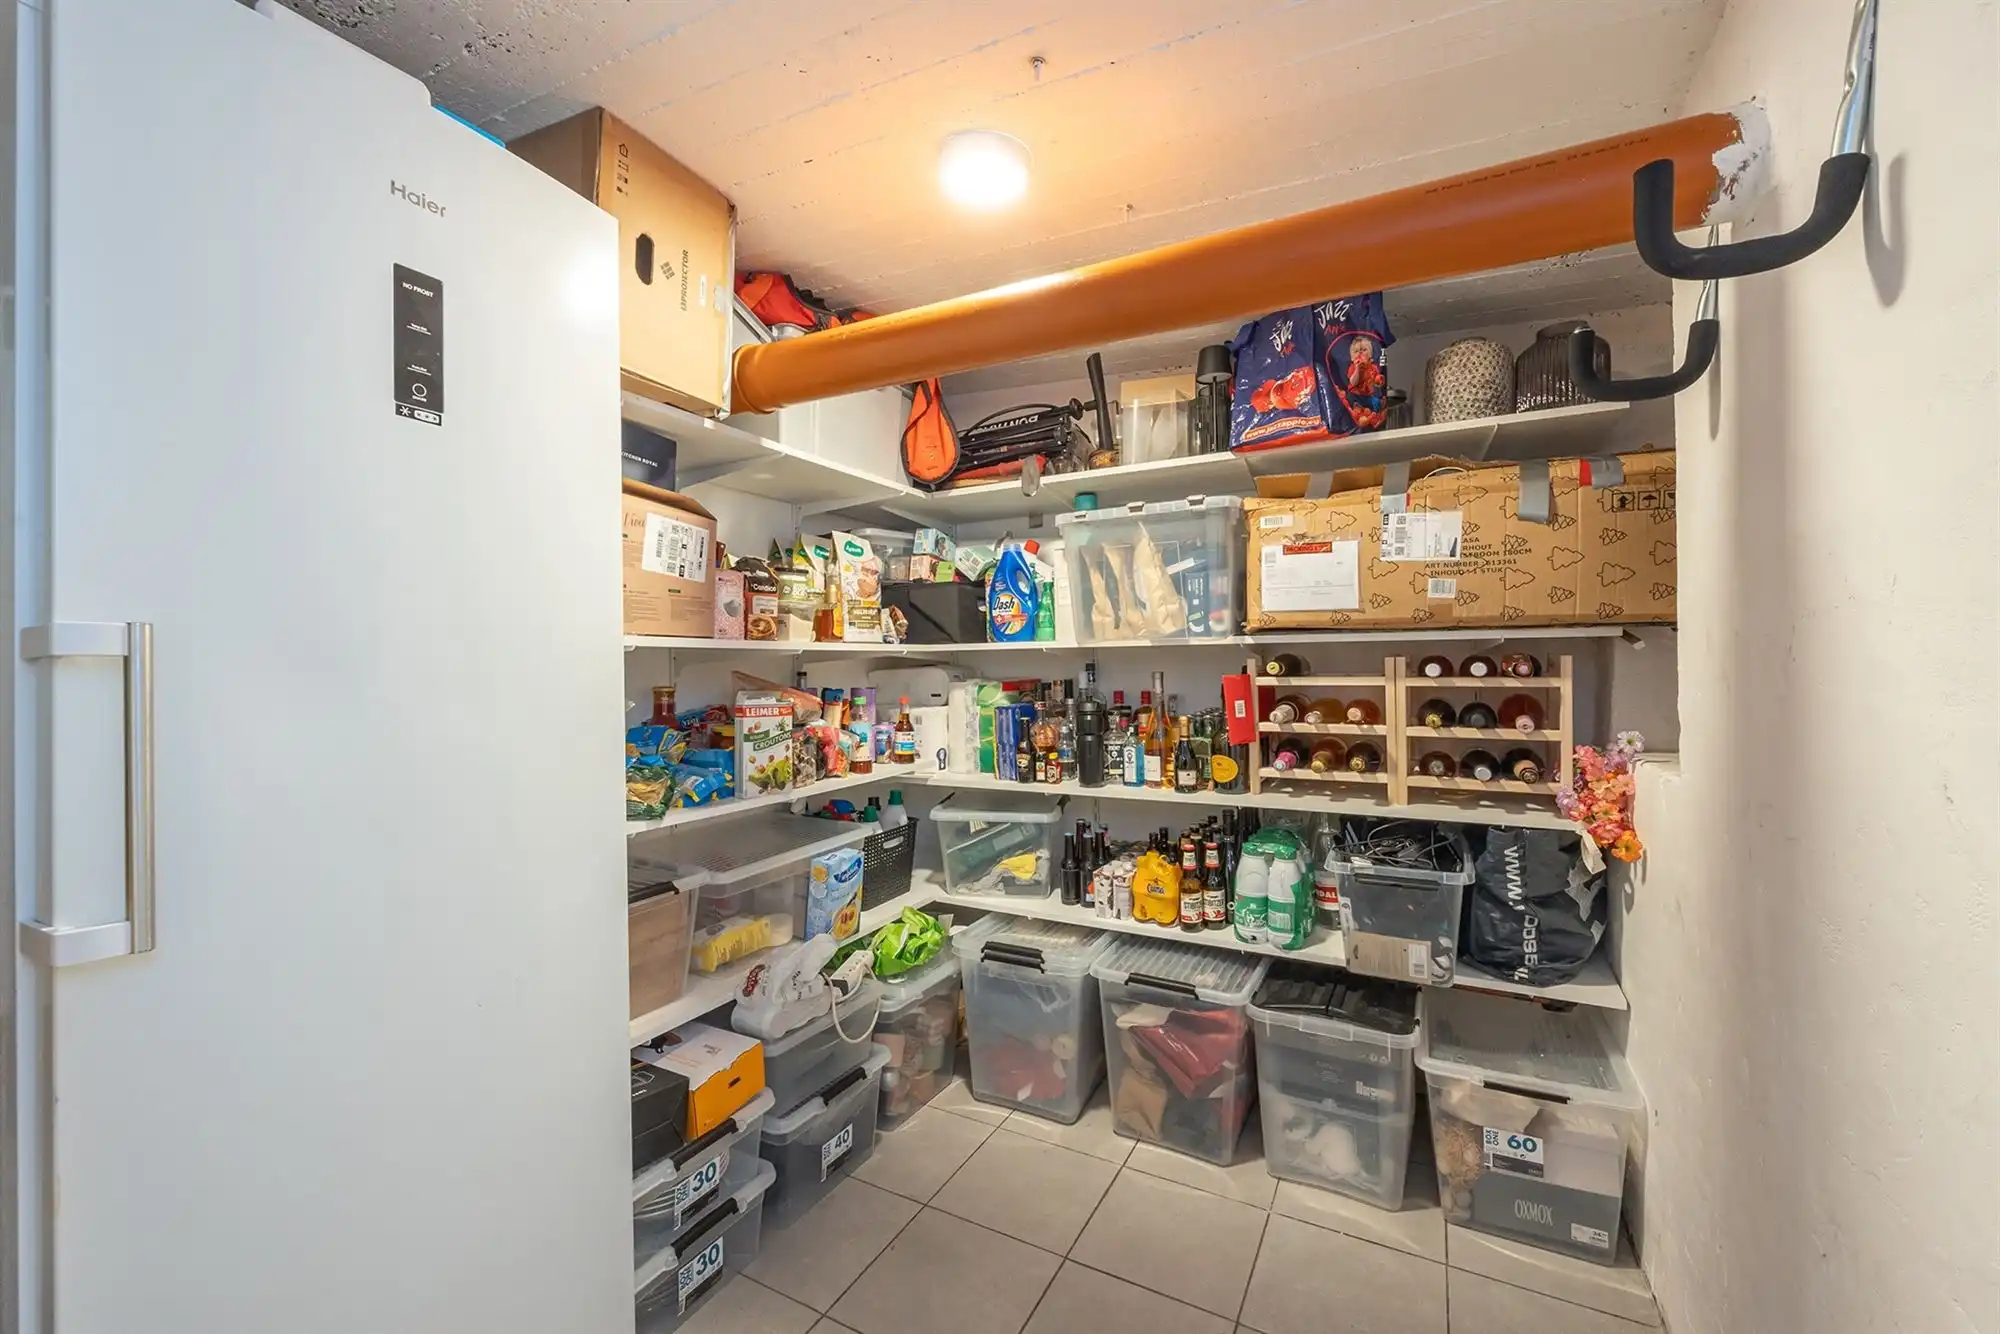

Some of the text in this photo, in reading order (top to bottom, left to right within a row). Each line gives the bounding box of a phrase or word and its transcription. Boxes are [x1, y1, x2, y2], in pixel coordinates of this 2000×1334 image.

[390, 179, 447, 217] Haier
[402, 281, 434, 298] NO FROST
[1314, 300, 1351, 330] JAZZ
[1461, 547, 1533, 559] STBOOM 180CM
[1462, 543, 1493, 551] RHOUT
[1425, 562, 1441, 570] ART
[1443, 560, 1479, 570] NUMBER
[993, 595, 1015, 610] Dash
[745, 707, 780, 717] LEIMER
[755, 731, 792, 750] CROUTONS
[835, 1129, 850, 1149] 40
[1492, 1130, 1500, 1146] ONE
[1507, 1135, 1538, 1153] 60
[692, 1162, 717, 1192] 30
[1514, 1199, 1554, 1227] OXMOX
[696, 1243, 720, 1276] 30
